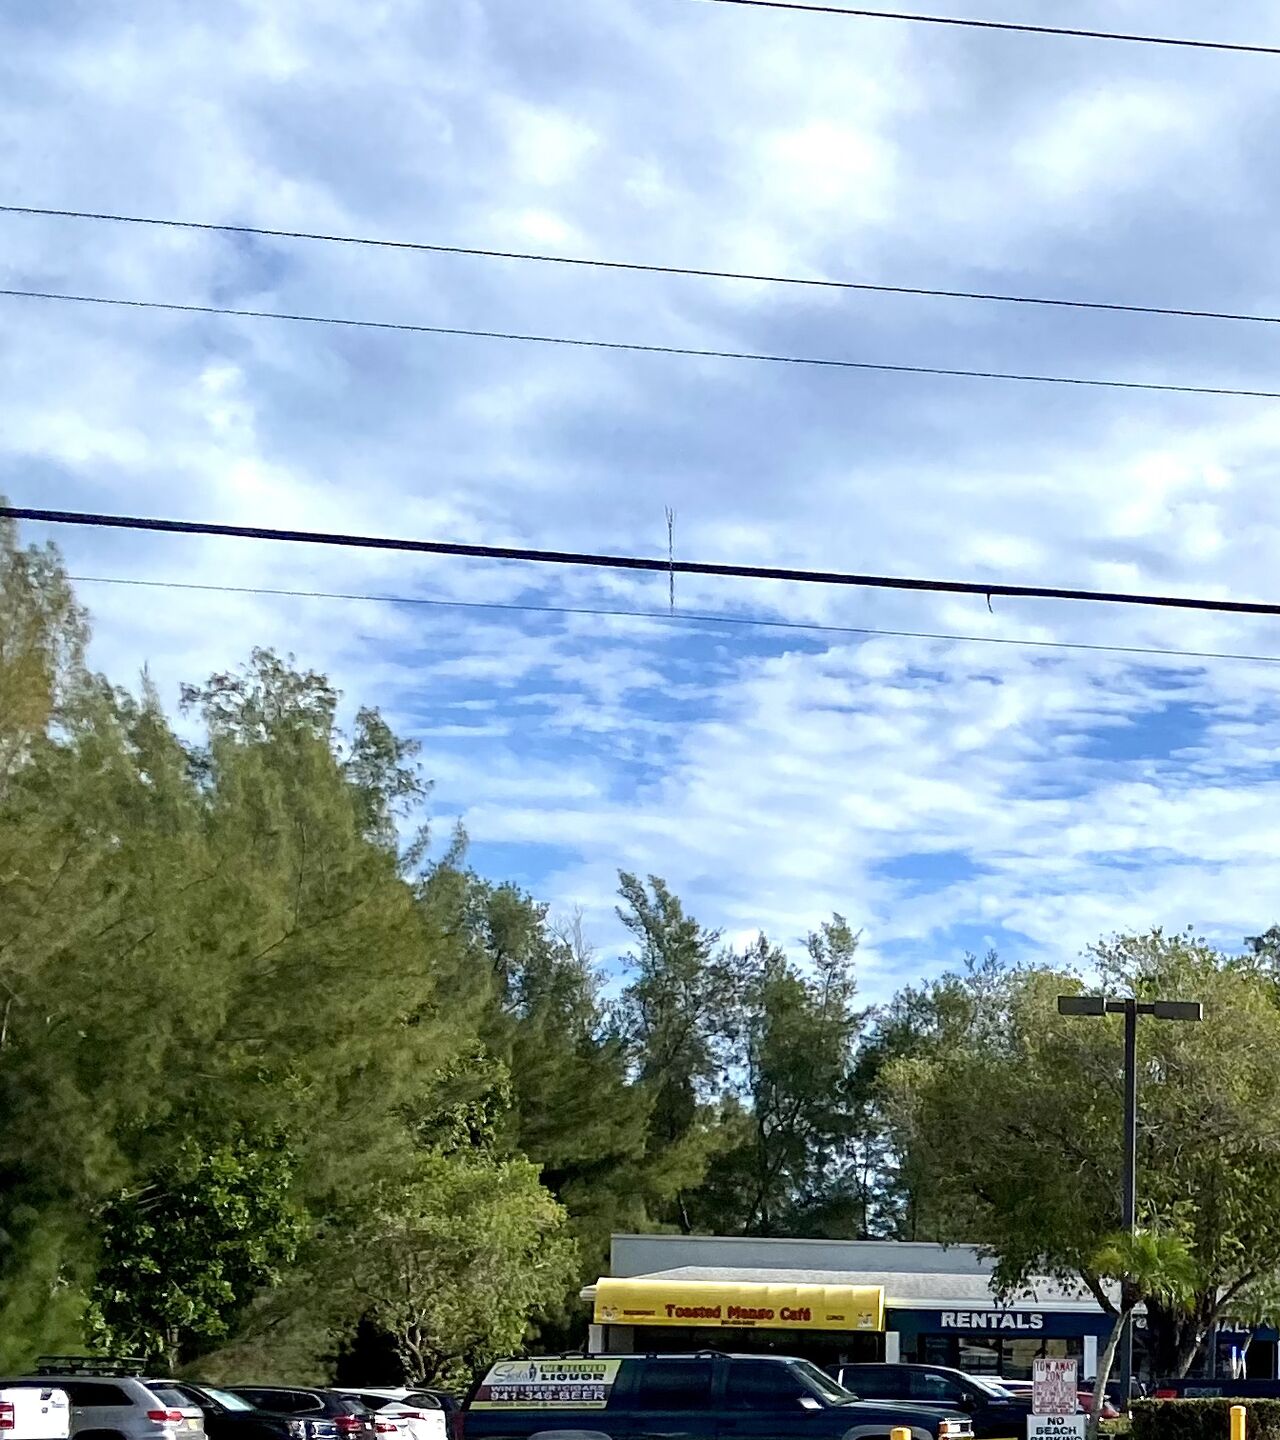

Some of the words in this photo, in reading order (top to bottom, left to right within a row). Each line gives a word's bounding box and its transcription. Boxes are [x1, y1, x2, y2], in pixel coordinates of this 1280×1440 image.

[665, 1304, 721, 1319] Toasted
[941, 1311, 1044, 1329] RENTALS
[541, 1373, 605, 1381] LIQUOR
[1047, 1416, 1065, 1426] NO
[1036, 1426, 1077, 1435] BEACH
